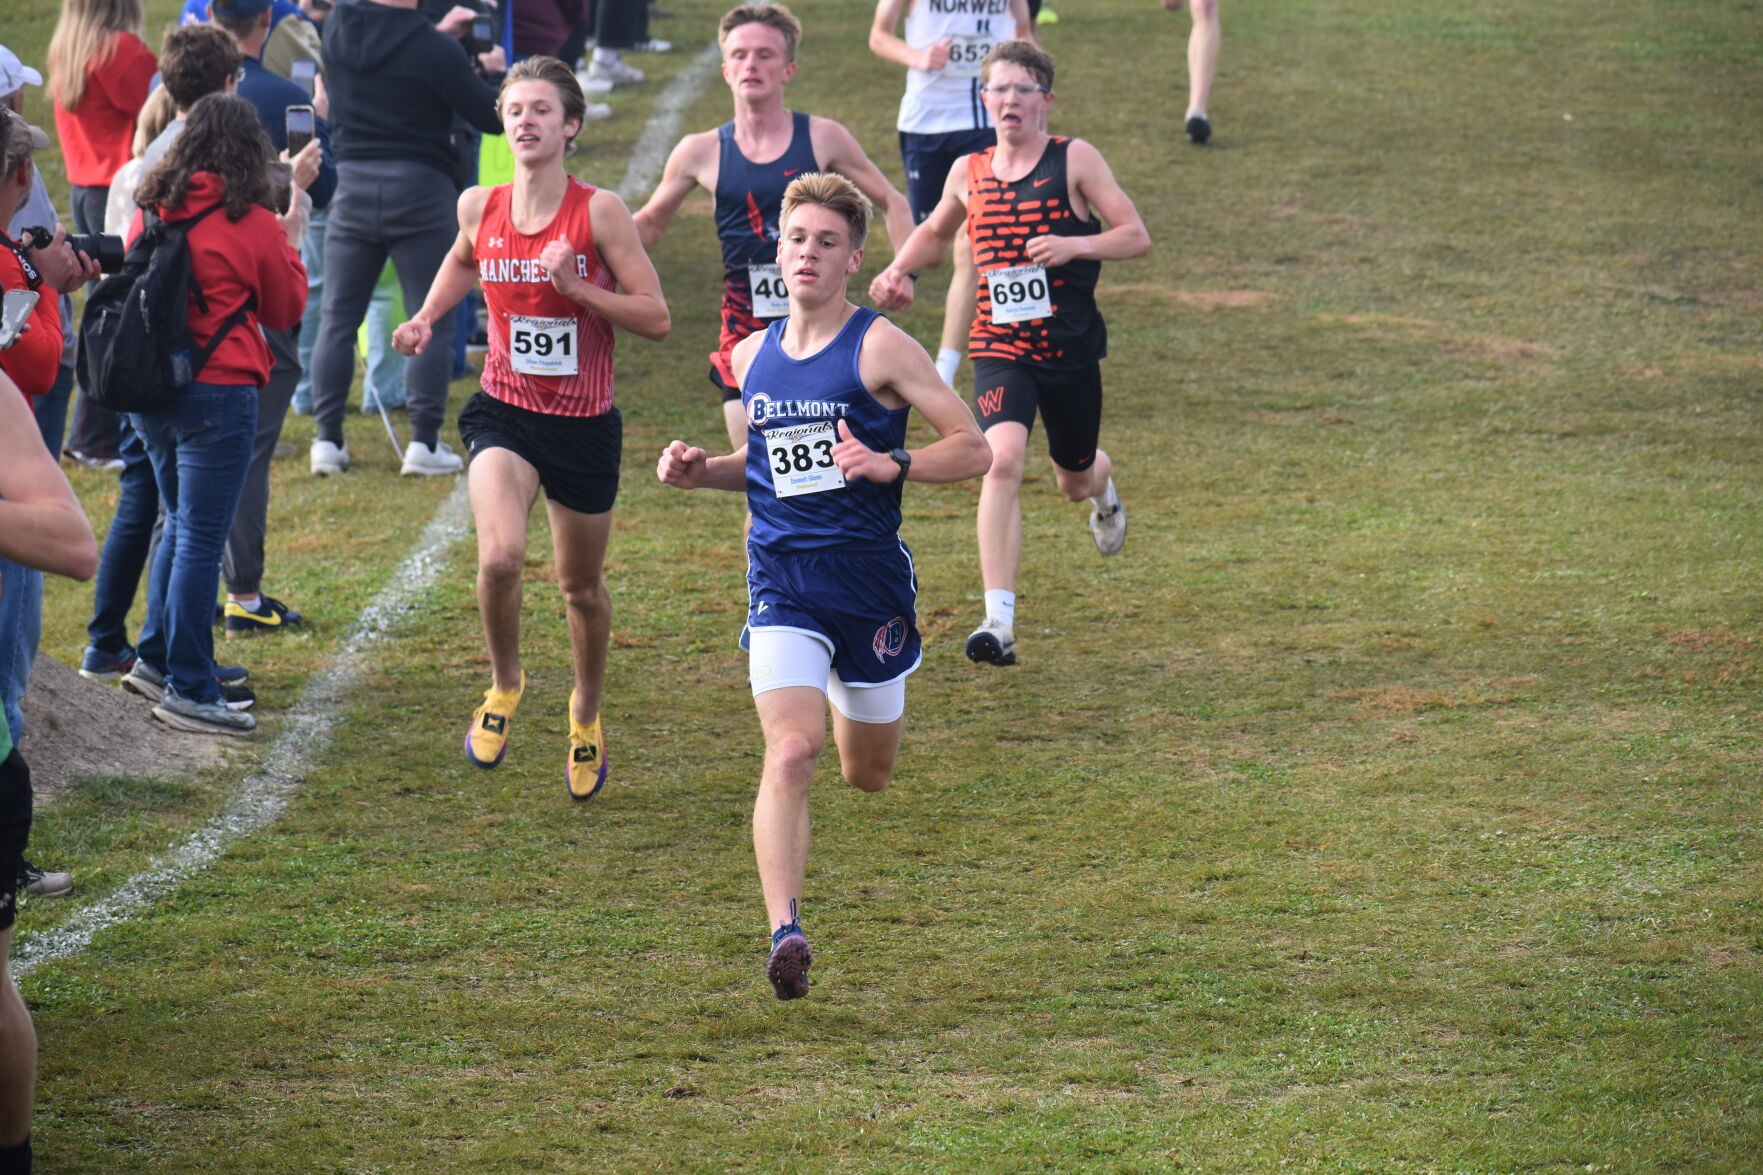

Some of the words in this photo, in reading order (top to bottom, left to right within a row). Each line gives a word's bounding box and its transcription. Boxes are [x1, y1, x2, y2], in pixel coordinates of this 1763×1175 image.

[480, 254, 588, 283] MANCHESR
[993, 278, 1046, 305] 690
[514, 330, 571, 356] 591
[753, 398, 849, 420] BELLMONT
[977, 386, 1004, 417] W
[766, 421, 833, 440] Regionals
[771, 440, 835, 475] 383
